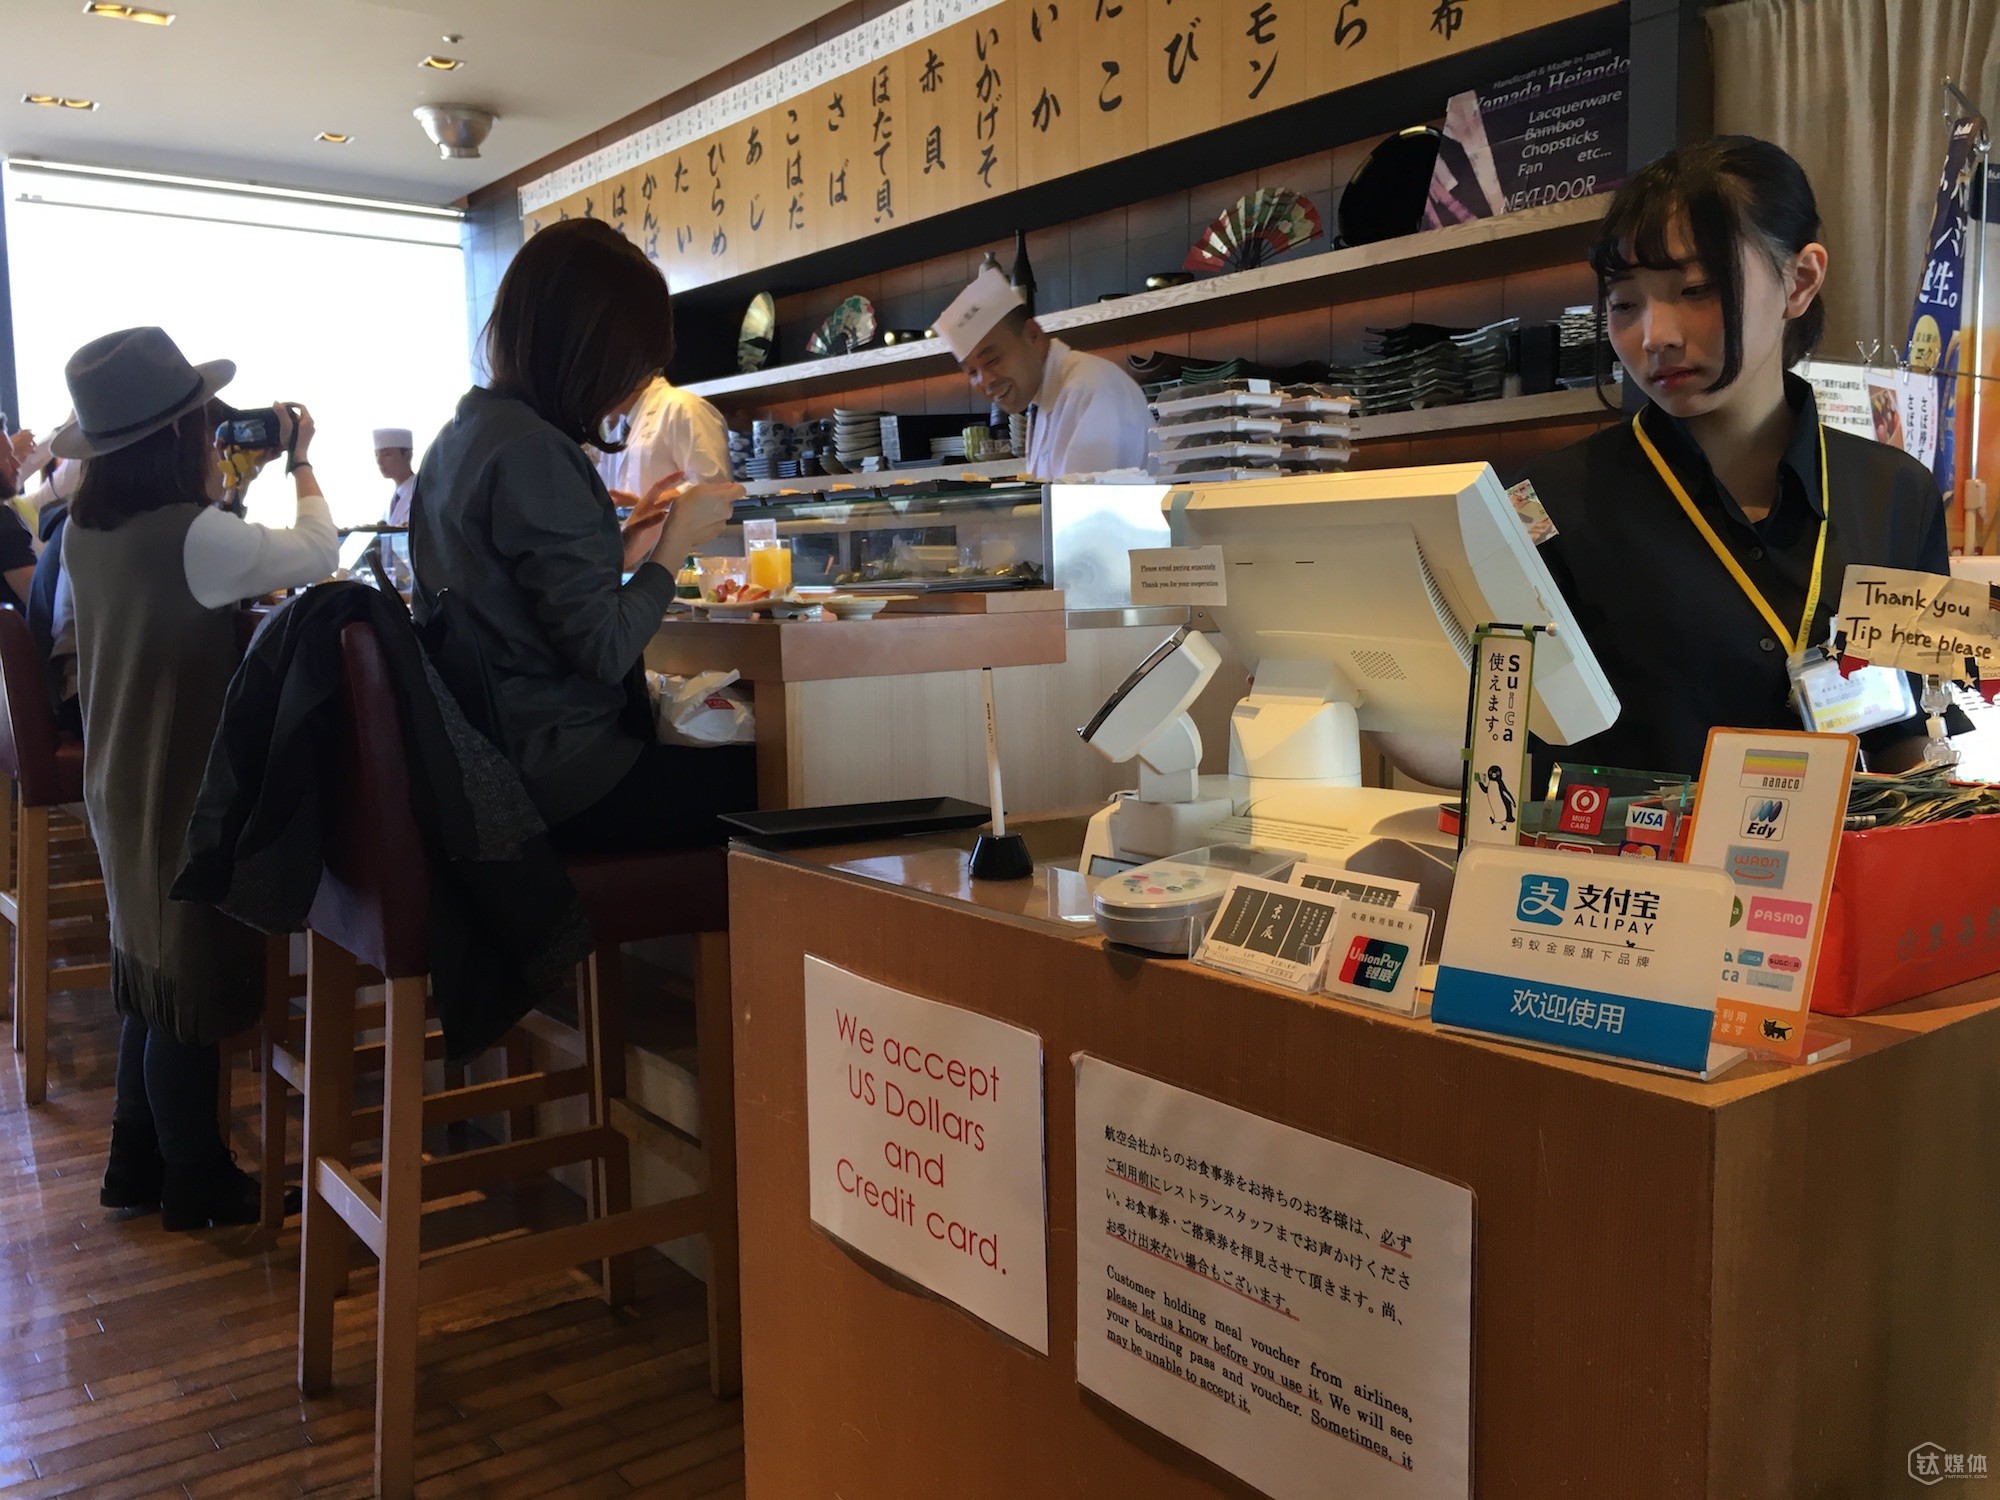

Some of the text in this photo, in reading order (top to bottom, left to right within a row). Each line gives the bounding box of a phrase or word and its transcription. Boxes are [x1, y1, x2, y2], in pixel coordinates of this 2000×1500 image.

[1164, 0, 1201, 84] び
[1547, 59, 1572, 73] Made
[1585, 48, 1612, 63] Japan
[1031, 4, 1061, 132] いか
[919, 48, 946, 175] 赤貝
[976, 26, 1003, 189] いかげそ
[1524, 116, 1585, 141] Bamboo
[1529, 90, 1622, 124] Lacquerware
[828, 92, 850, 207] さば
[871, 65, 894, 225] ほたて貝
[1518, 147, 1612, 177] Fan etc...
[1521, 130, 1599, 159] Chopsticks
[747, 125, 765, 232] あじ
[785, 109, 806, 231] こはだ
[674, 155, 692, 253] たい
[707, 143, 727, 257] ひらめ
[1501, 175, 1597, 214] NEXT DOOR
[1856, 581, 1970, 617] Thank you
[1846, 617, 1992, 663] Tip here please
[1485, 652, 1505, 741] 使えます。
[1503, 654, 1520, 742] Suica
[1762, 776, 1800, 790] nanaco
[1570, 822, 1590, 831] CARD
[1571, 815, 1591, 824] MUFG
[1631, 810, 1663, 827] VISA
[1746, 822, 1776, 838] Edy
[1574, 884, 1660, 920] 支付宝
[1574, 914, 1654, 935] ALIPAY
[1754, 908, 1804, 926] PASMO
[1349, 946, 1401, 974] UnionPay
[1365, 965, 1394, 983] 银联
[1511, 936, 1651, 968] 蚂蚁金服旗下品牌
[1510, 988, 1626, 1034] 欢迎使用
[835, 1008, 1000, 1102] We accept
[848, 1064, 985, 1152] US Dollars
[884, 1140, 944, 1188] and
[836, 1158, 1007, 1276] Credit card.
[1106, 1218, 1292, 1316] お受け出来ない場合もございます。
[1107, 1265, 1413, 1424] Customer holding meal voucher from airlines,
[1107, 1286, 1413, 1445] please let us know before you use it. We will see
[1107, 1329, 1251, 1415] may be unable to accept it.
[1107, 1309, 1413, 1471] your boarding pass and voucher. Sometimes, it
